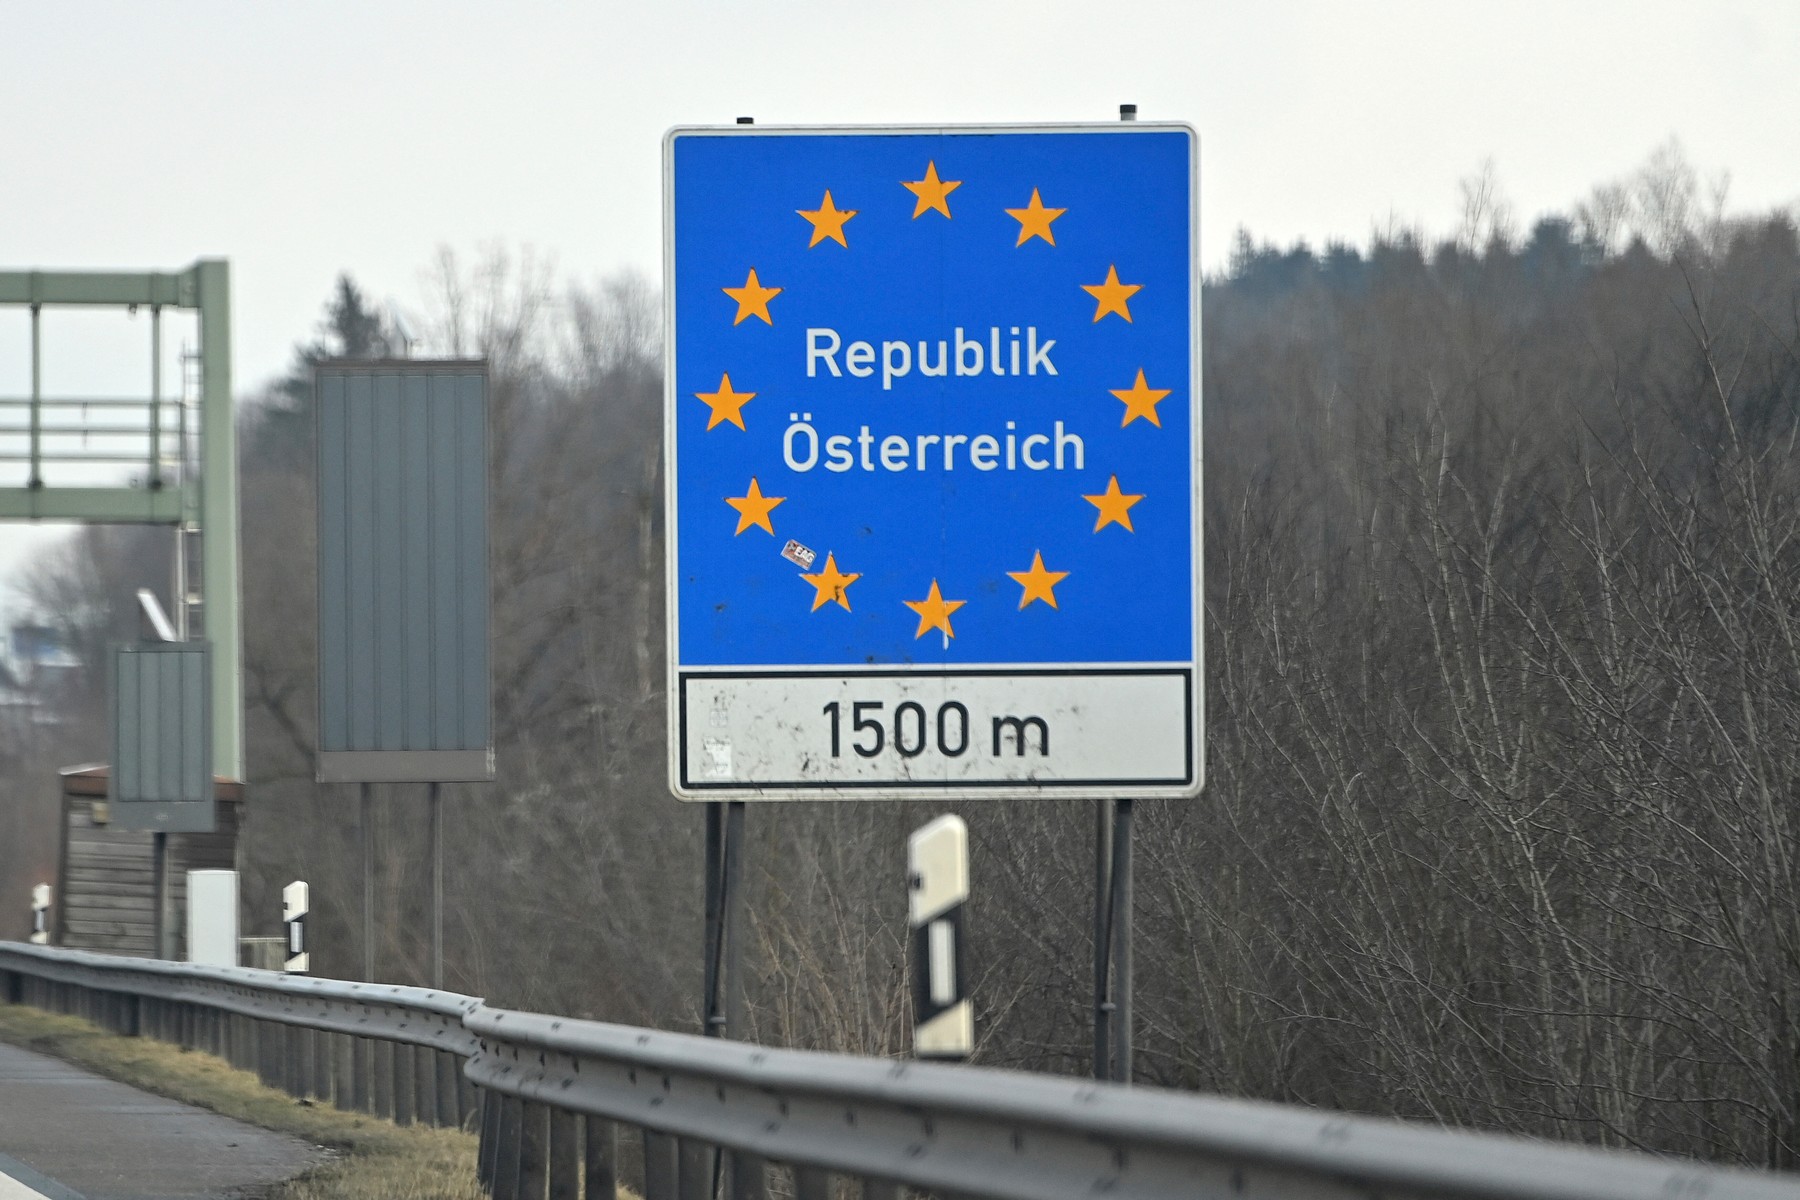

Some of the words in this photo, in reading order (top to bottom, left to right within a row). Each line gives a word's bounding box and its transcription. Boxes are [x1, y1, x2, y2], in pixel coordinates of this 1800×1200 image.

[806, 326, 1058, 391] Republik
[783, 412, 1084, 473] Österreich
[823, 701, 969, 759] 1500
[992, 716, 1049, 757] m
